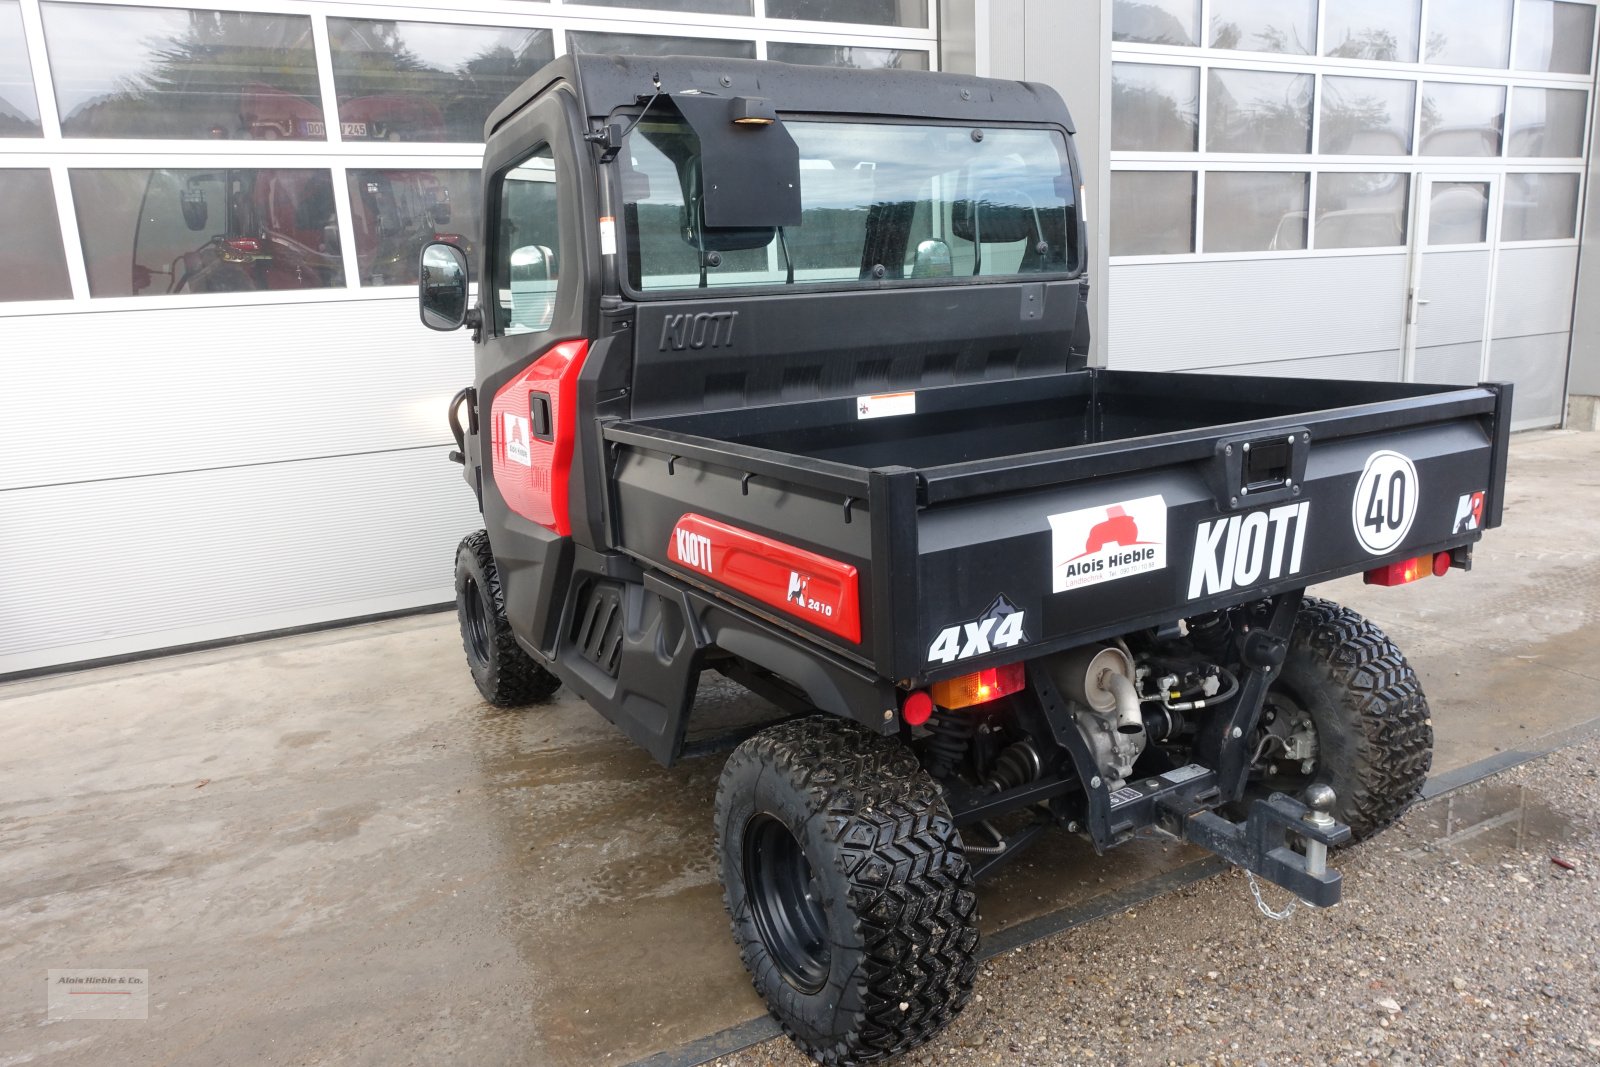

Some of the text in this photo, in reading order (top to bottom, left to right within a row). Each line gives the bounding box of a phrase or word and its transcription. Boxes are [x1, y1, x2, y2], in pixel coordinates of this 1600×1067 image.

[348, 124, 366, 135] 245
[659, 310, 739, 352] KIOTI
[1364, 470, 1406, 533] 40
[676, 527, 713, 573] KIOTI
[1066, 548, 1155, 578] Alois Hieble
[1187, 501, 1310, 600] KIOTI
[808, 598, 832, 617] 2410
